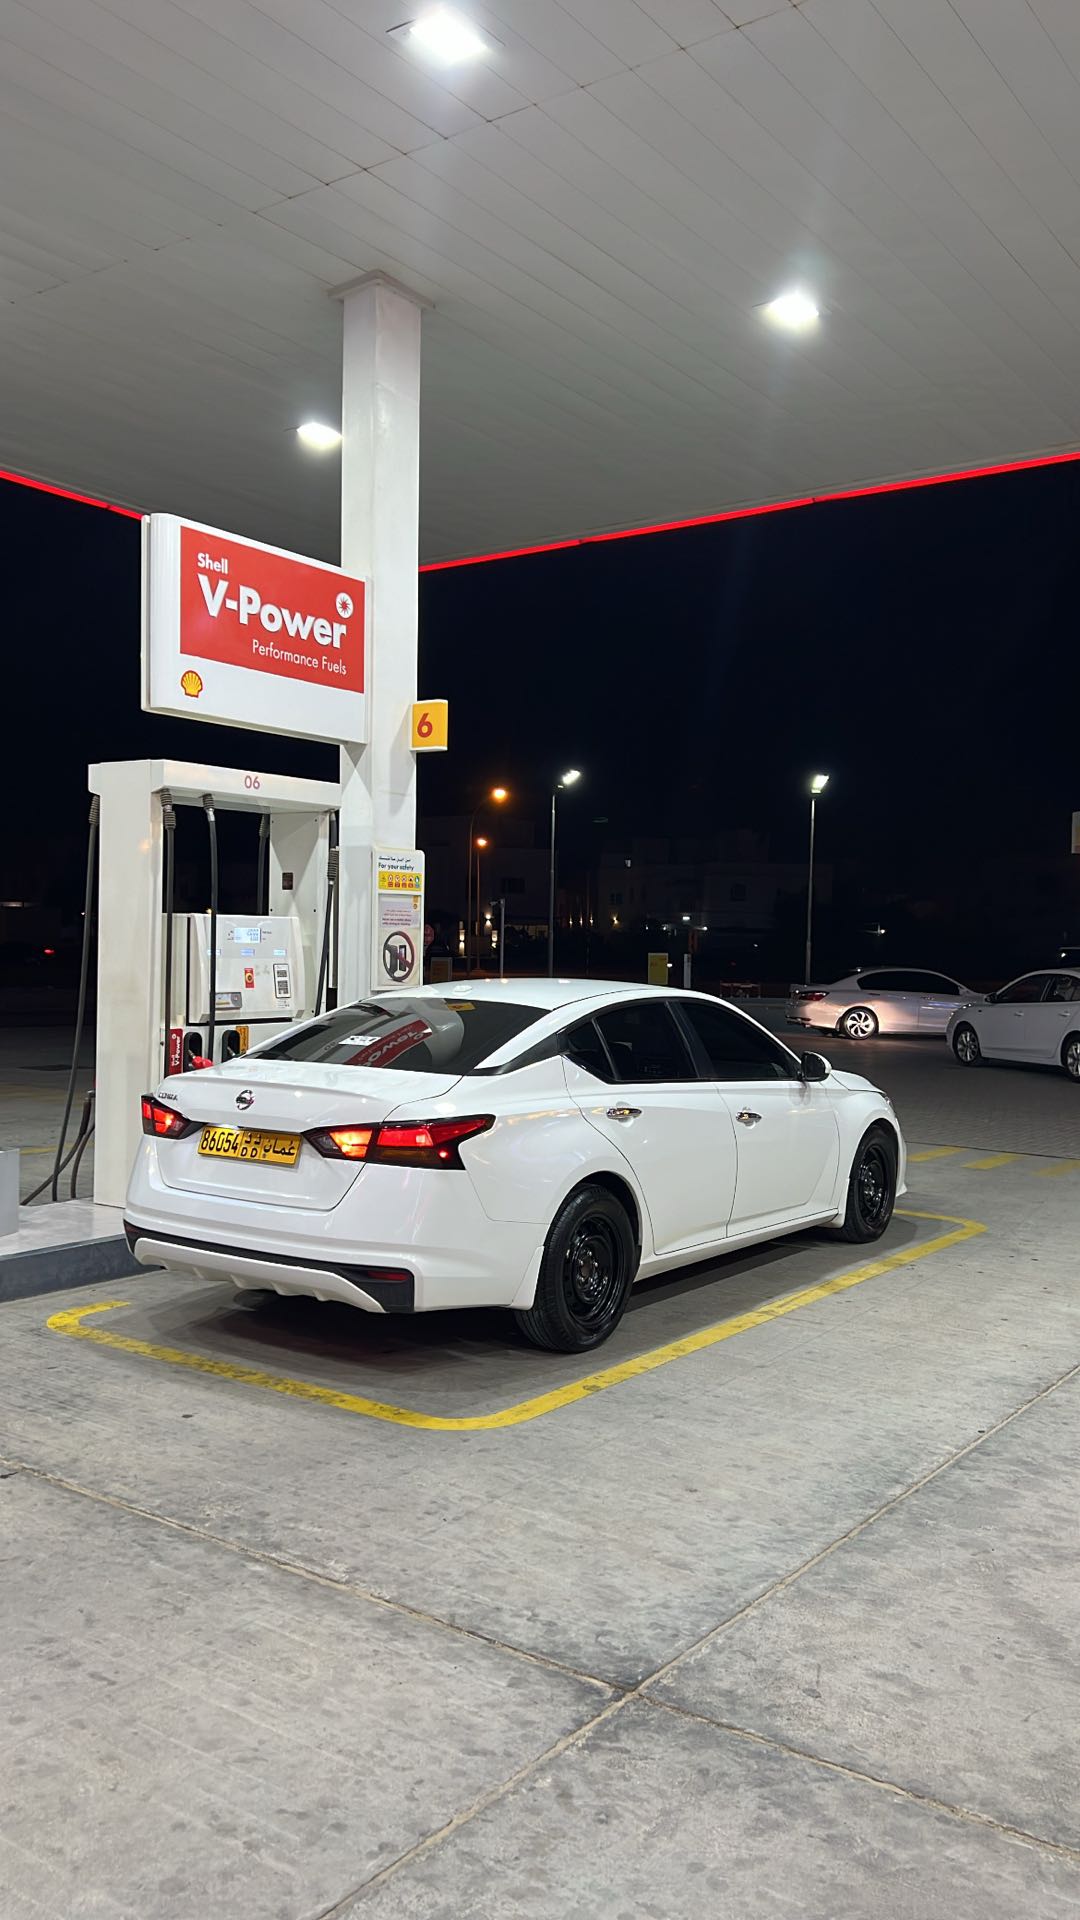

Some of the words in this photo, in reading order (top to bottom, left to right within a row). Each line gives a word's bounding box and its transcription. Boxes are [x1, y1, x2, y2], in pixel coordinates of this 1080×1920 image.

[197, 552, 228, 574] Shell
[197, 573, 347, 649] V-Power
[252, 639, 319, 669] Performance
[321, 655, 347, 676] Fuels
[416, 712, 433, 738] 6
[244, 775, 261, 790] 06
[399, 863, 414, 872] safety
[201, 1130, 240, 1154] 86054
[240, 1146, 248, 1157] D
[250, 1147, 258, 1158] D
